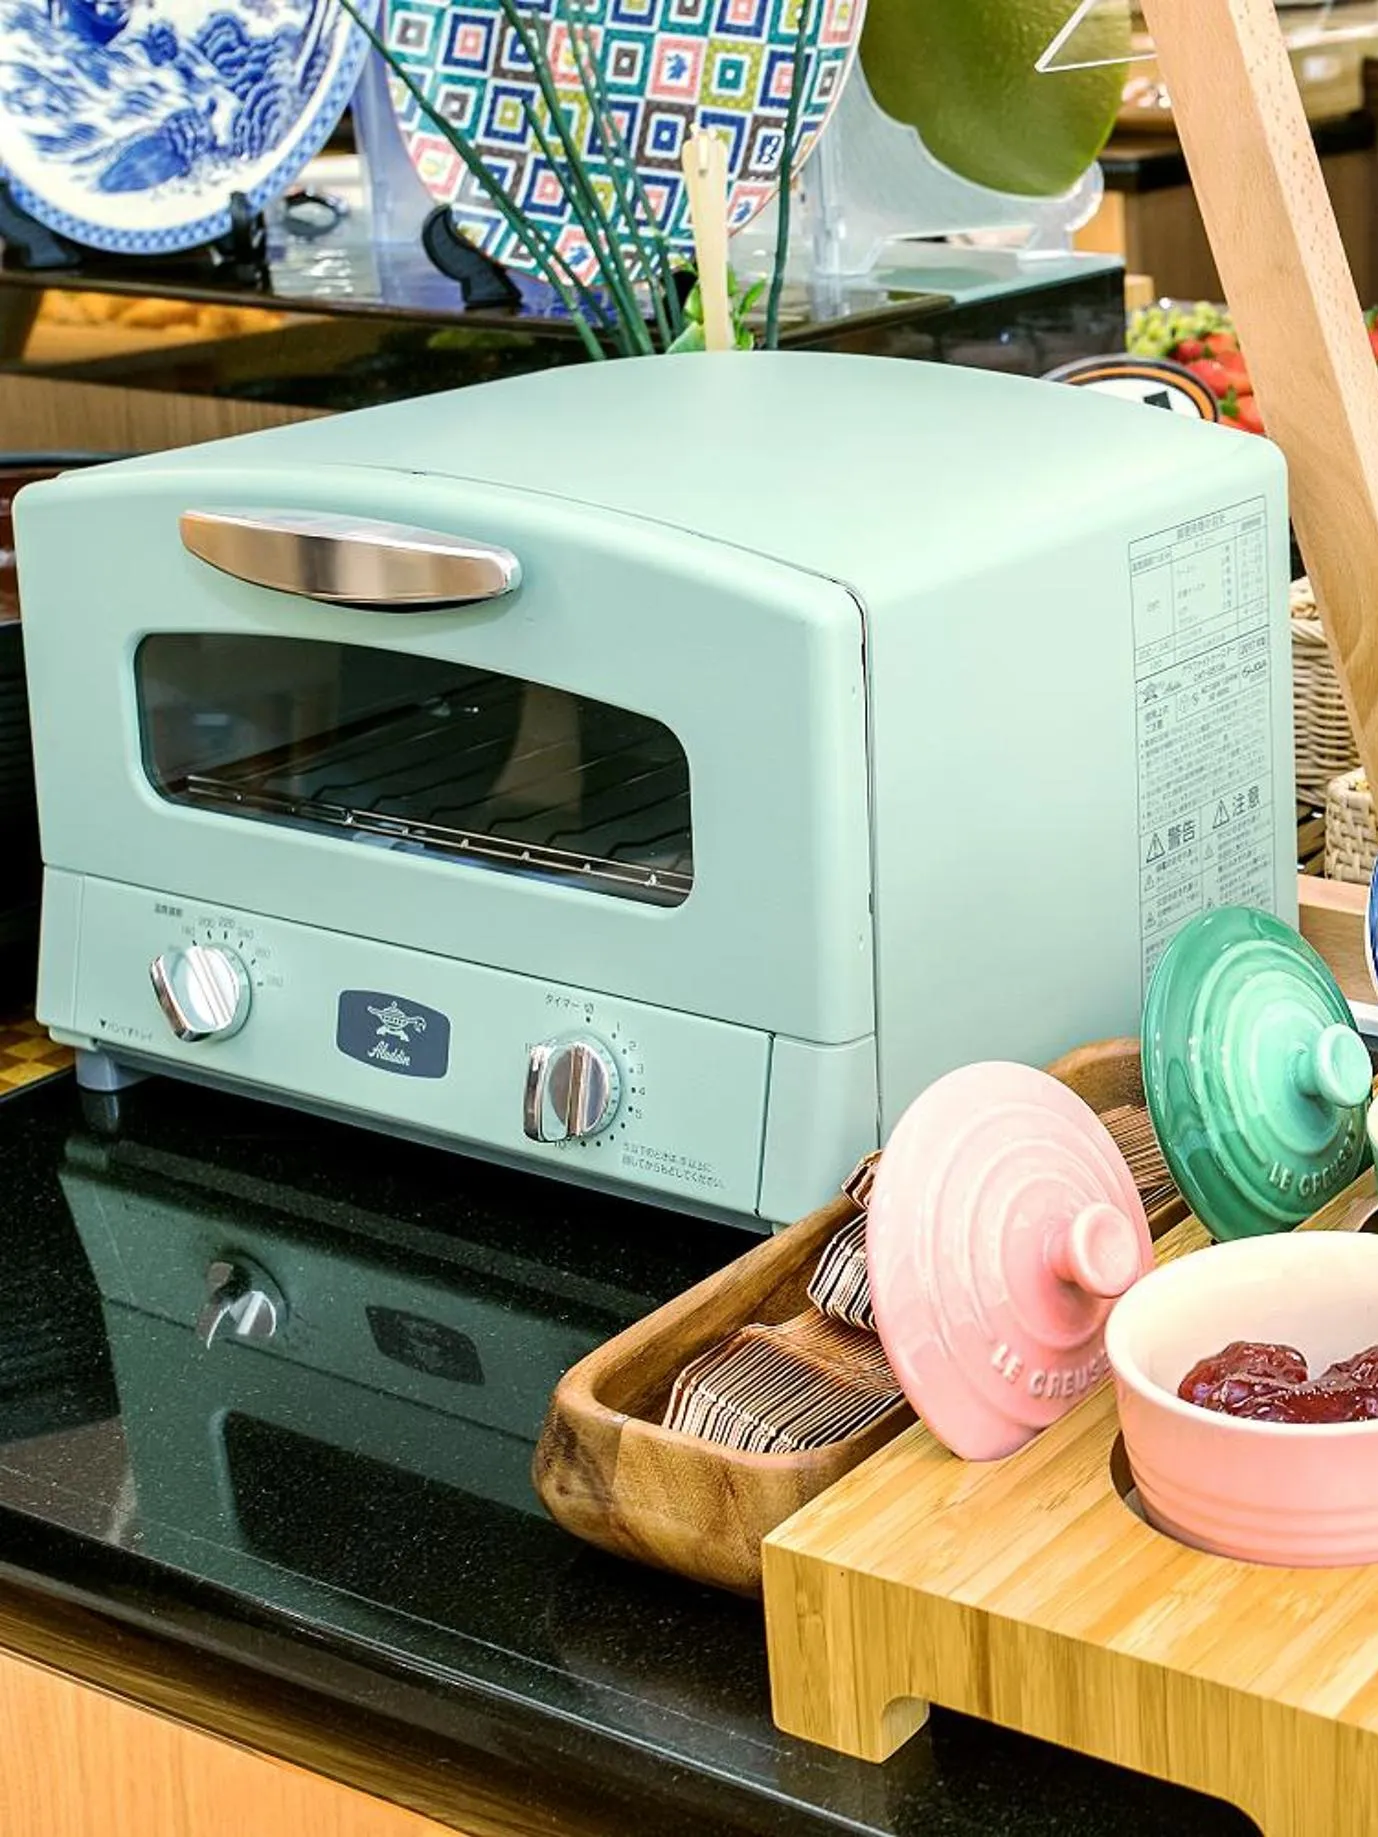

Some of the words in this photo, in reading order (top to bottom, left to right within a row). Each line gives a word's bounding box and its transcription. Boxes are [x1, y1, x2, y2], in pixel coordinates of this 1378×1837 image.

[1232, 784, 1260, 817] 注意
[1167, 820, 1197, 851] 警告
[544, 995, 580, 1008] タイマー
[367, 1040, 411, 1067] Aladdin
[638, 1086, 646, 1098] 4
[634, 1109, 643, 1121] 5
[1268, 1160, 1293, 1192] LE
[990, 1342, 1025, 1384] LE
